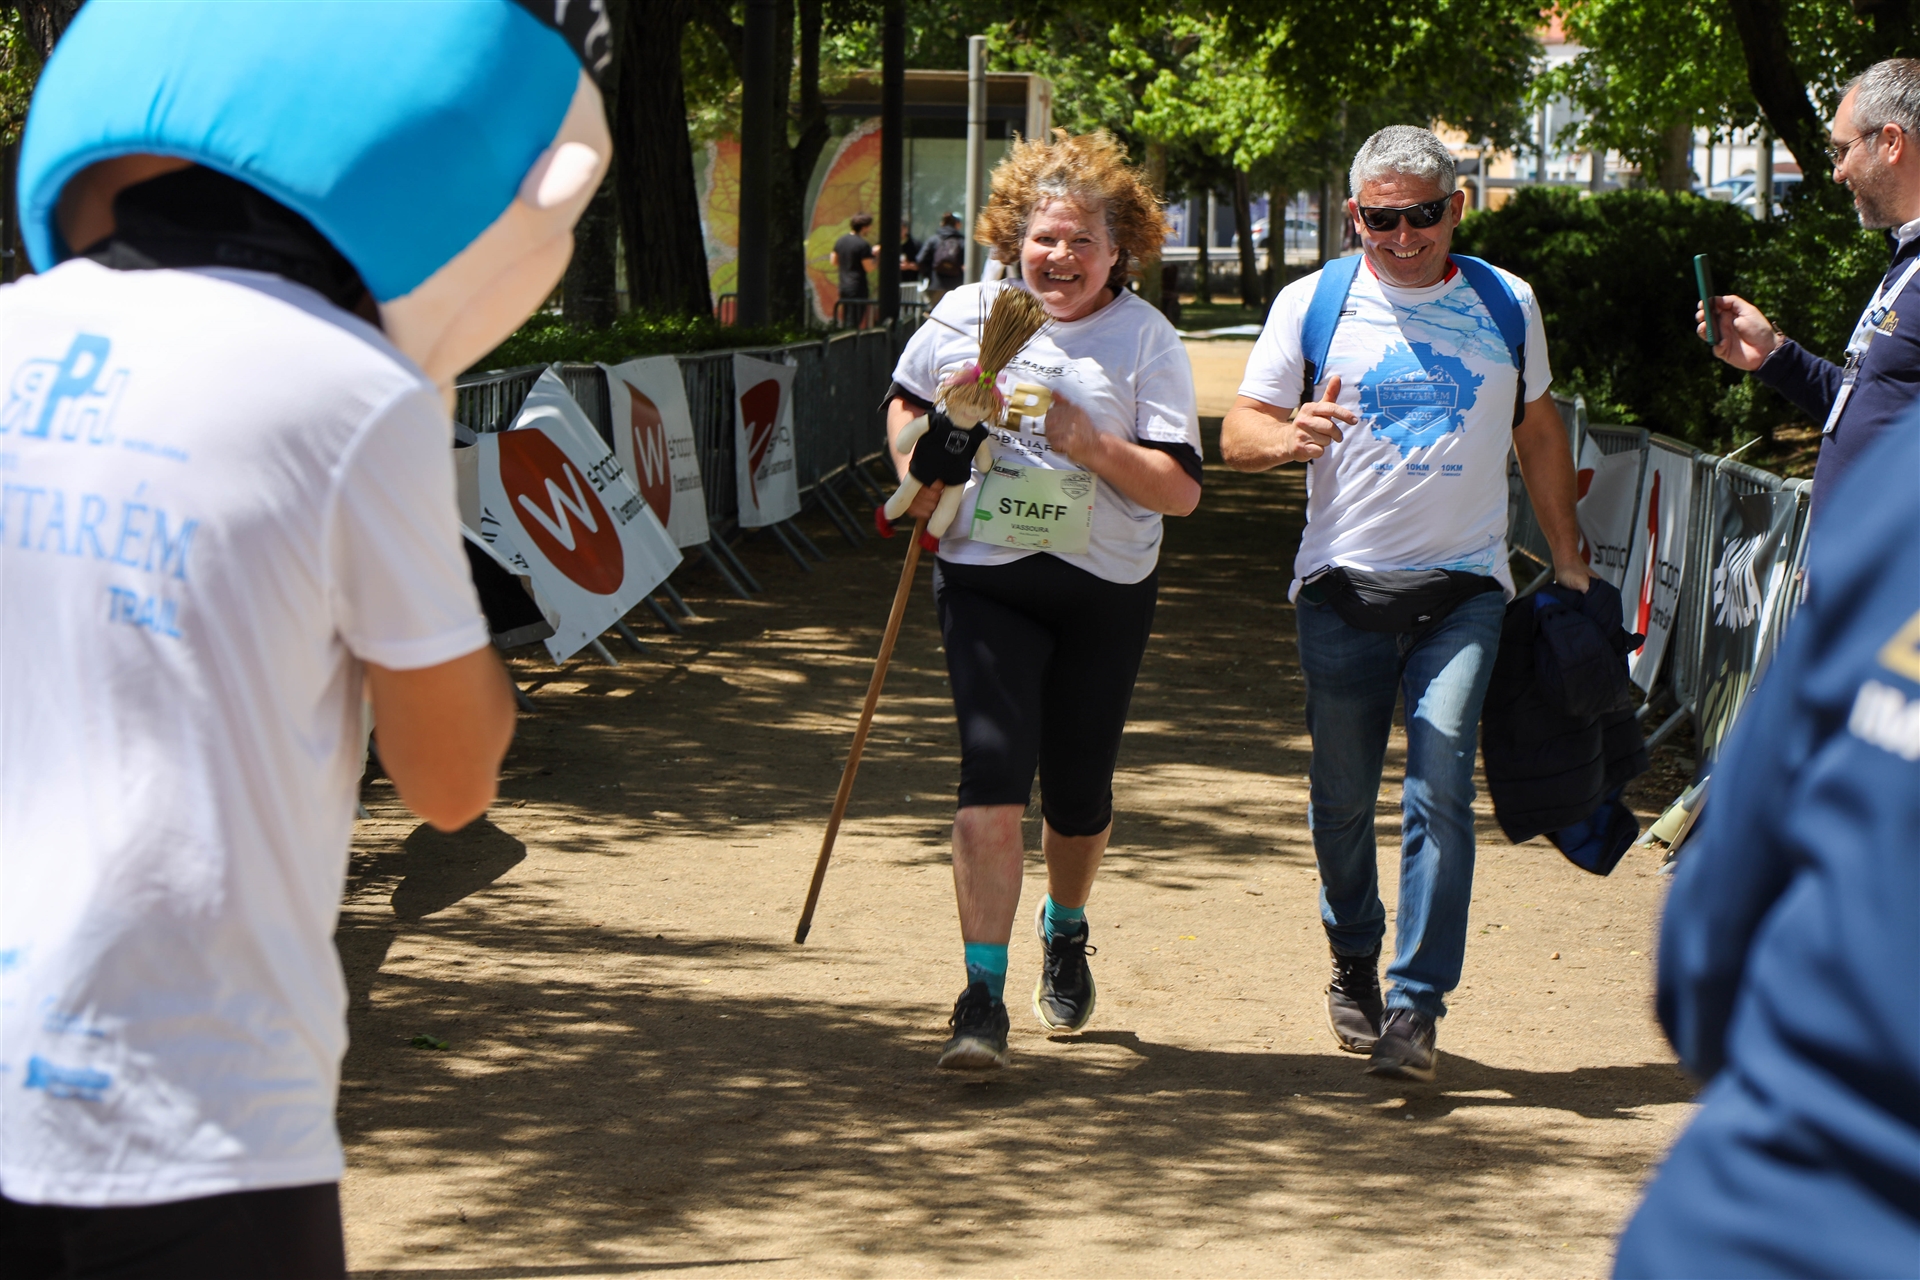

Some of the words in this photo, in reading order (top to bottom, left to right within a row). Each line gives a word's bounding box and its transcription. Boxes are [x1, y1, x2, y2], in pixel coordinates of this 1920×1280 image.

[1382, 389, 1450, 400] SANTARÉM
[1405, 463, 1430, 471] 10KM
[1441, 464, 1463, 472] 10KM
[998, 497, 1068, 521] STAFF
[1010, 522, 1050, 534] VASSOURA
[107, 584, 184, 641] TRAIL
